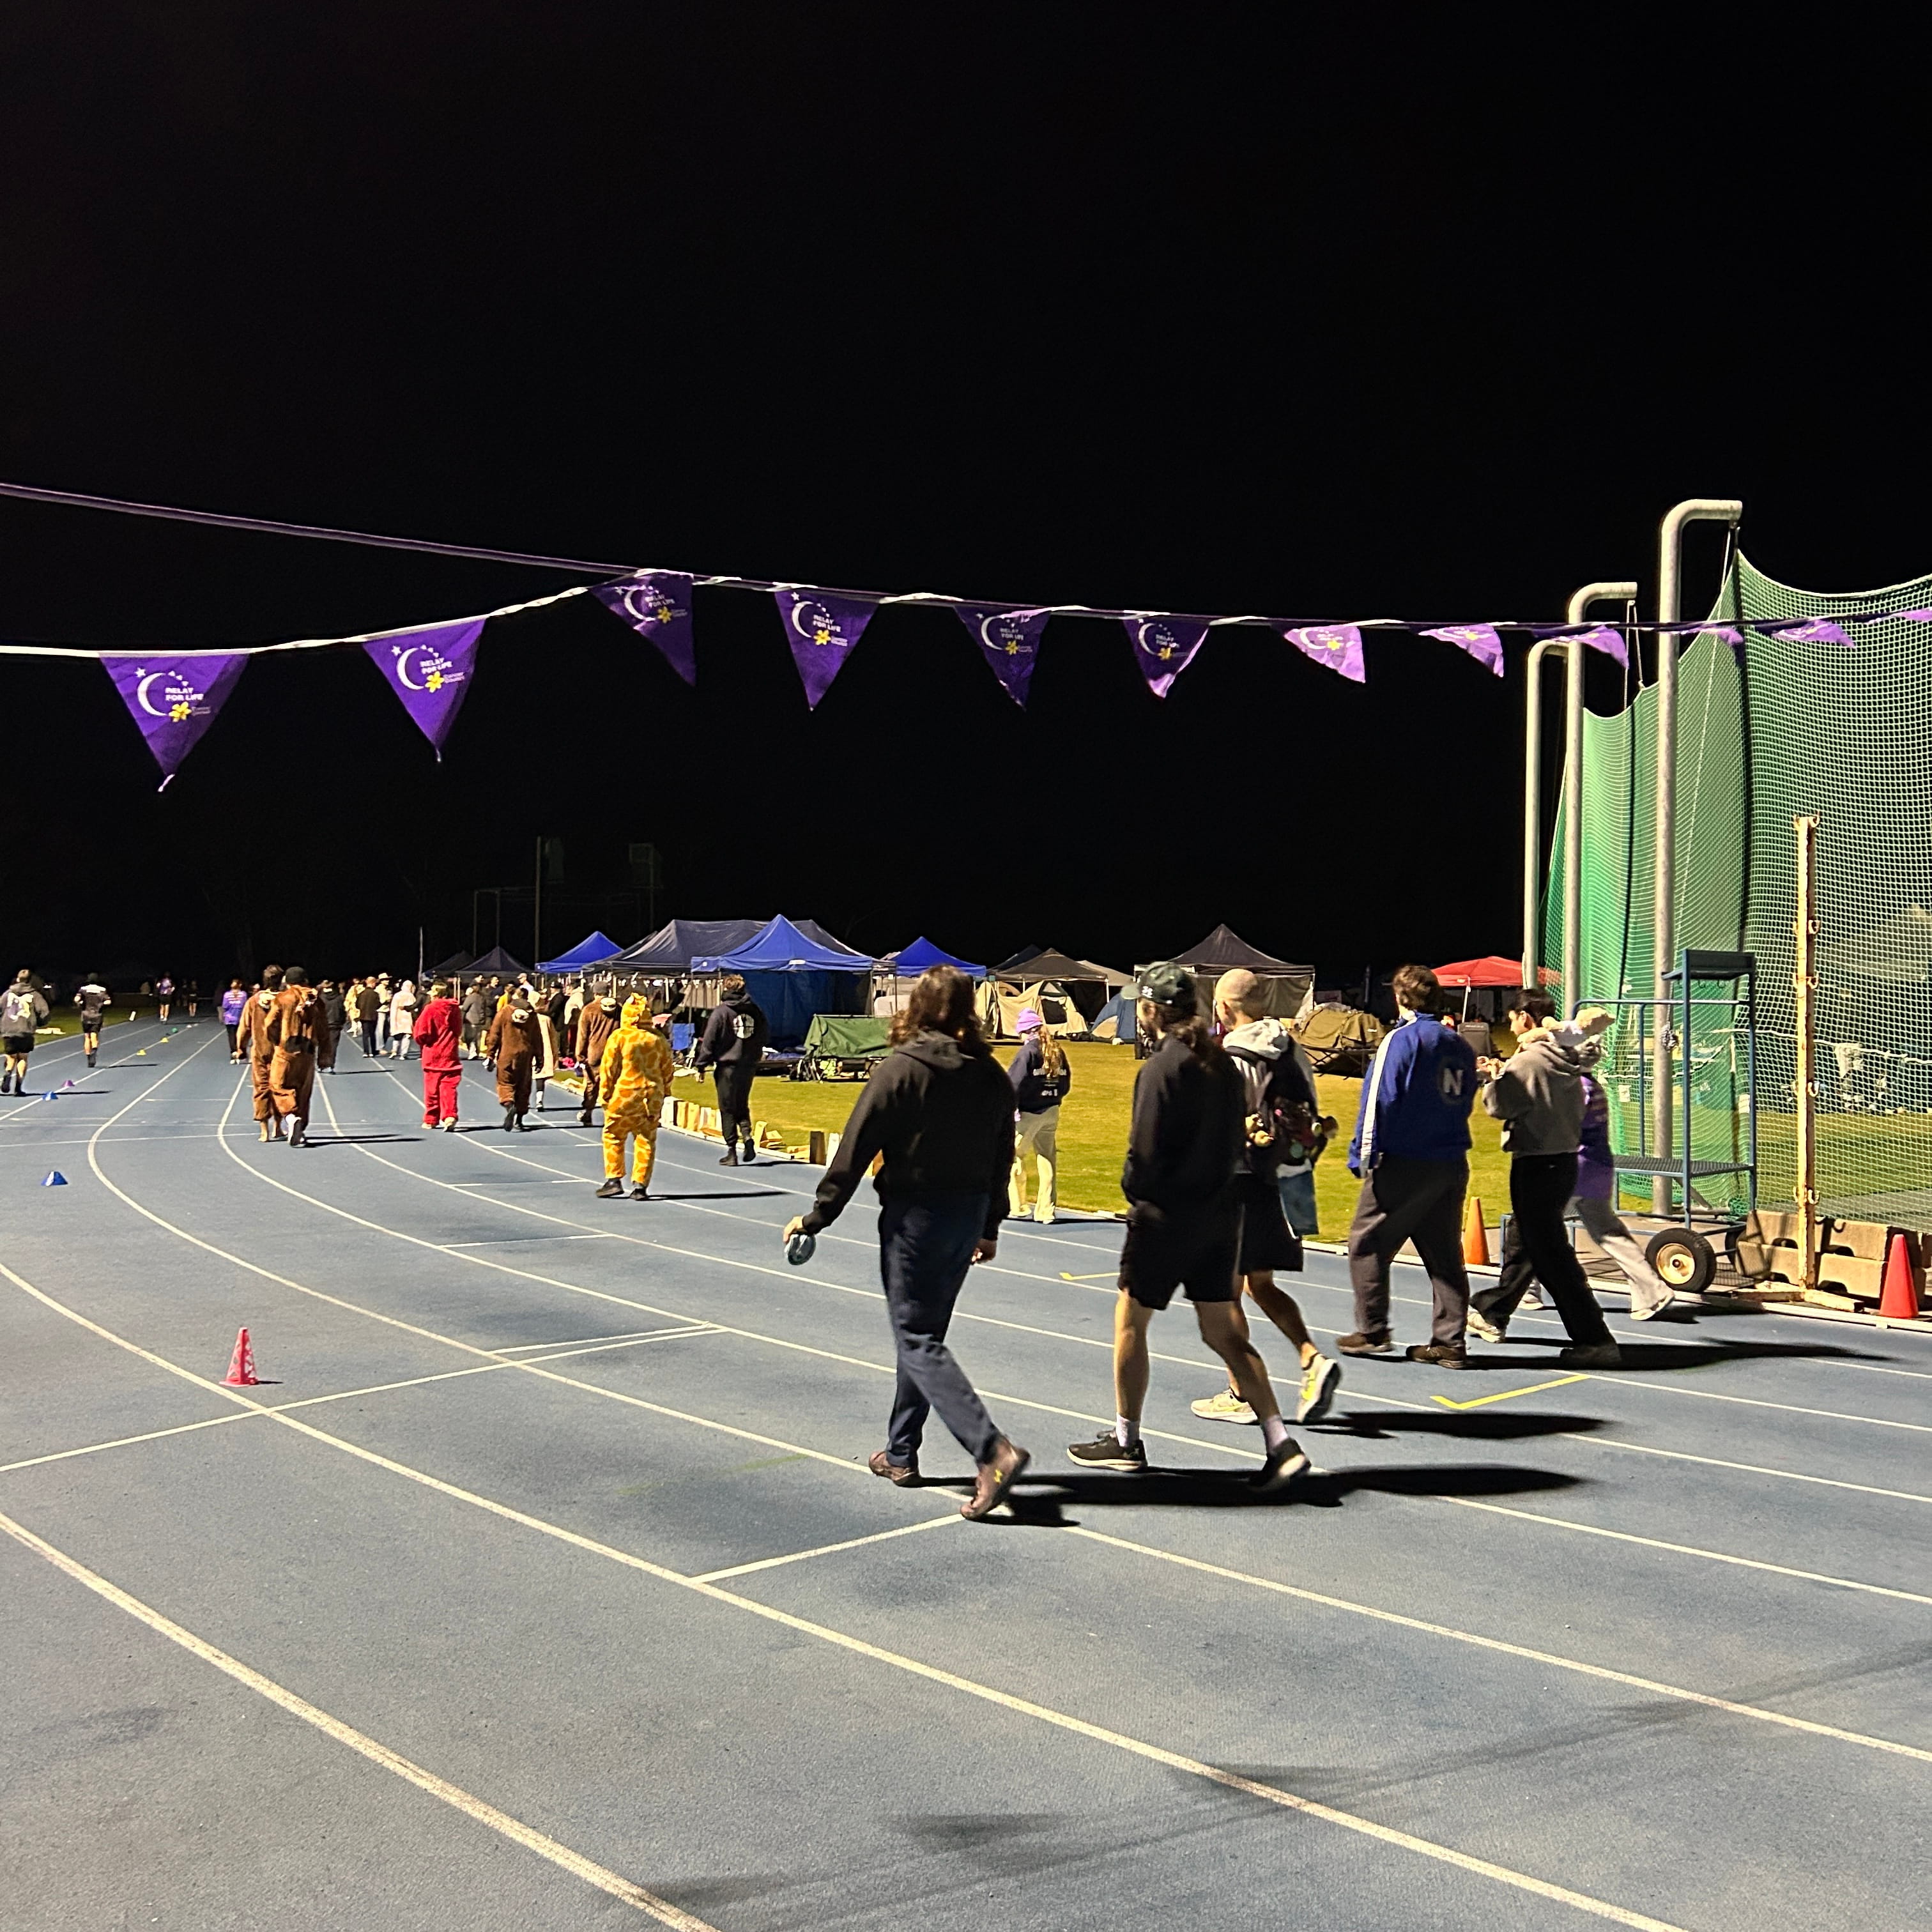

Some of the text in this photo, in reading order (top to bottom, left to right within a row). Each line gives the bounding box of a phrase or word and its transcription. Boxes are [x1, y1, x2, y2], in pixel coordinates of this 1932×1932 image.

[813, 614, 834, 625] RELAY
[813, 620, 841, 632] FOR LIFE
[420, 657, 445, 667] RELAY
[421, 661, 452, 675] FOR LIFE
[1443, 1068, 1464, 1096] N
